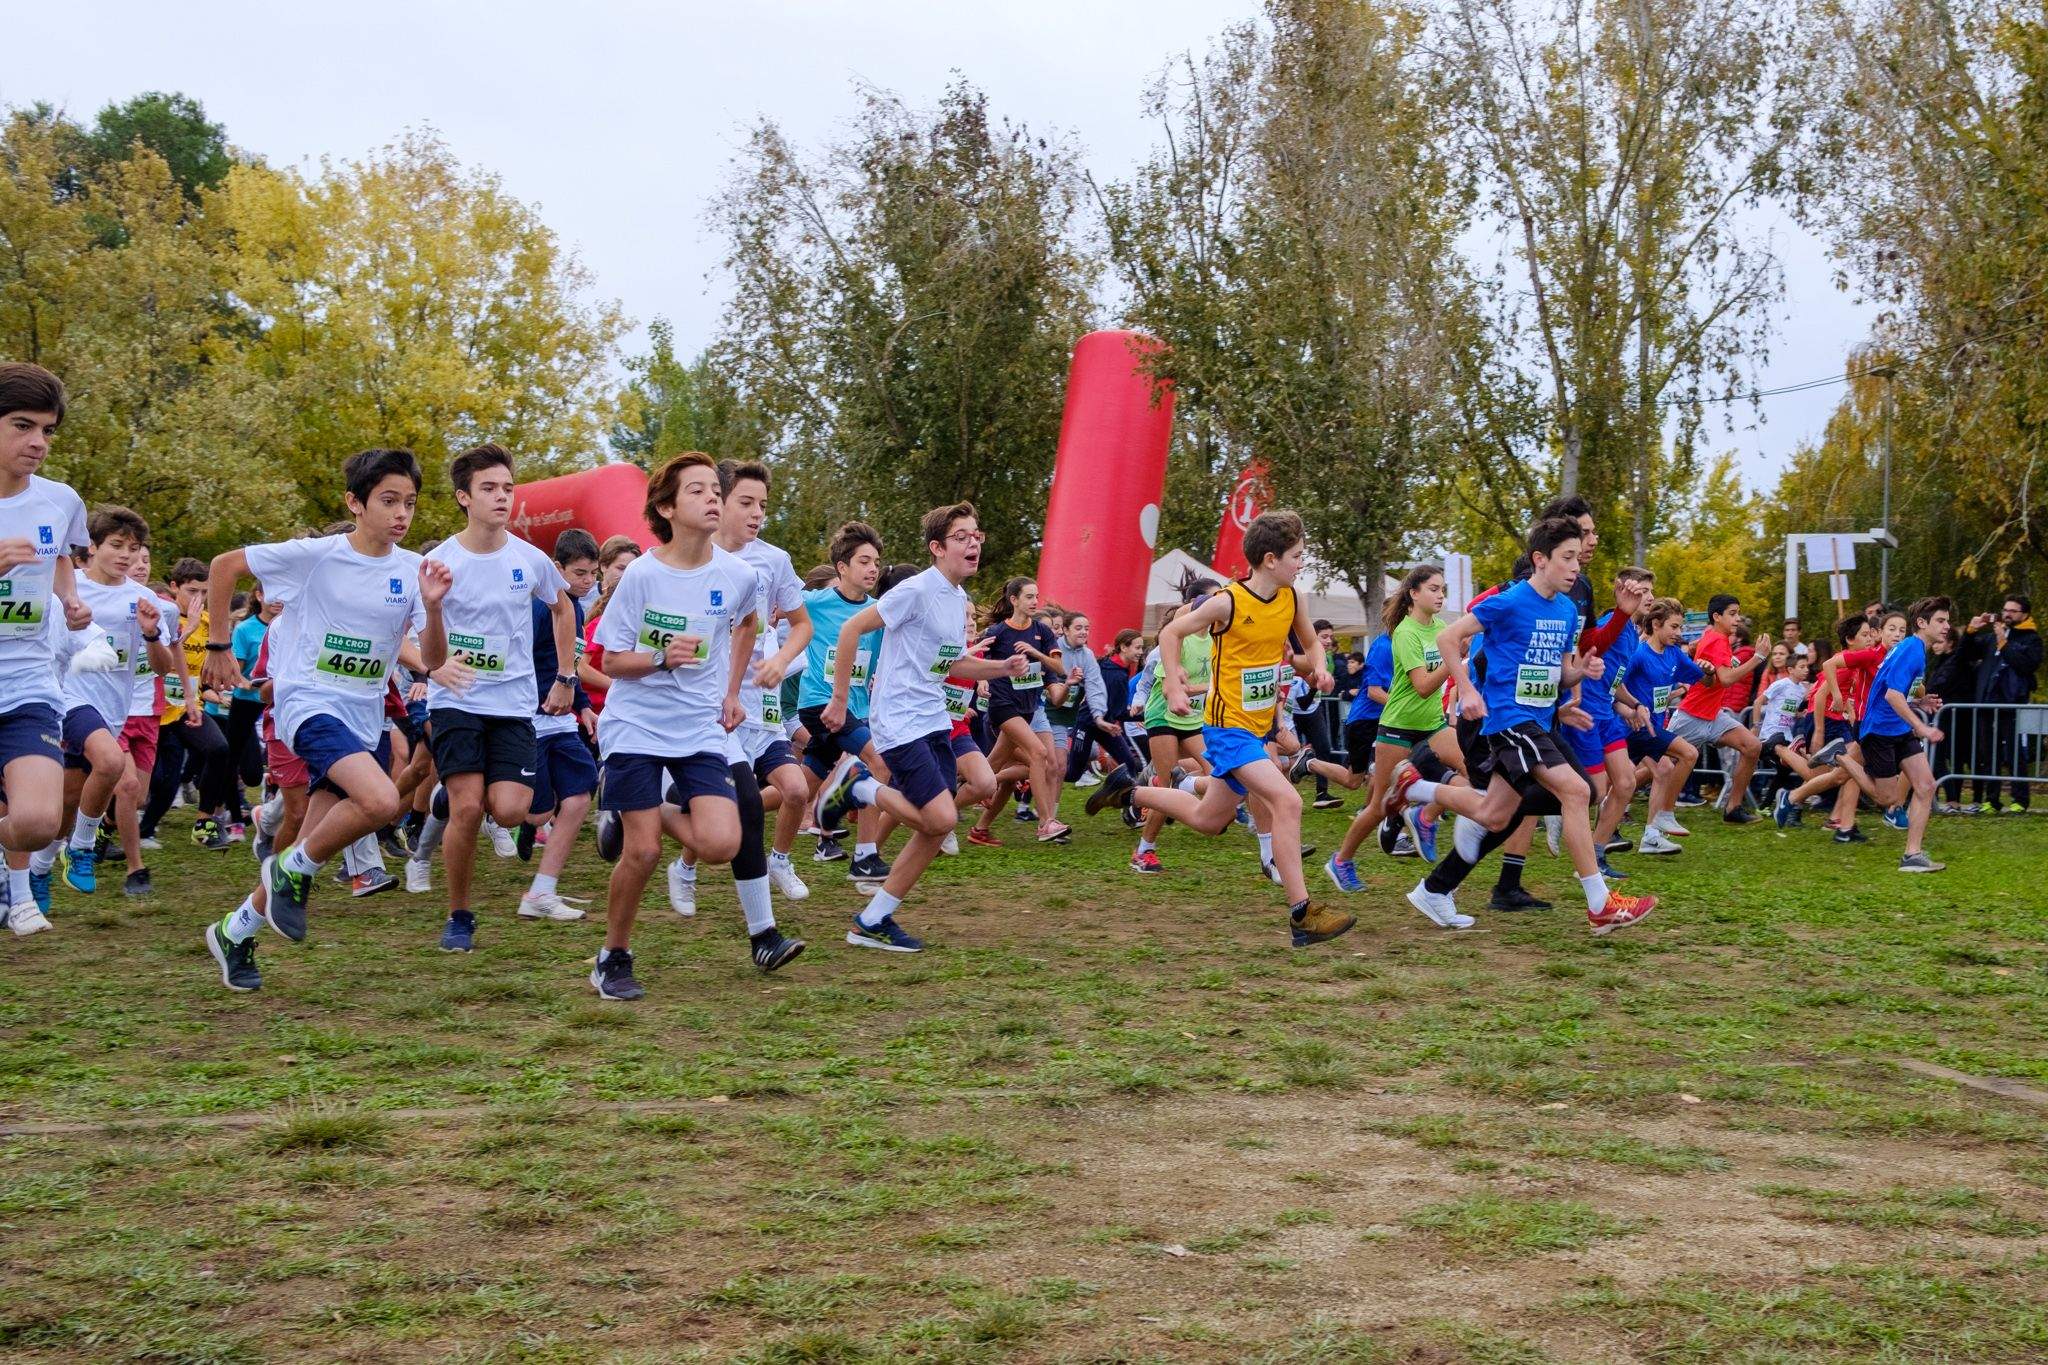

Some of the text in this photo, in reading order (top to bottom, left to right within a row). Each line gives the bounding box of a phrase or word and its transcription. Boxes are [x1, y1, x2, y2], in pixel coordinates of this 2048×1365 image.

[36, 545, 59, 555] VIARÓ
[509, 583, 528, 591] VIARÓ
[661, 616, 685, 626] CROS
[345, 639, 369, 649] CROS
[463, 637, 483, 645] CROS
[1525, 649, 1562, 664] CADE
[327, 653, 381, 675] 4670
[1257, 670, 1273, 679] CROS
[1250, 682, 1278, 700] 318
[1523, 682, 1555, 696] 3181
